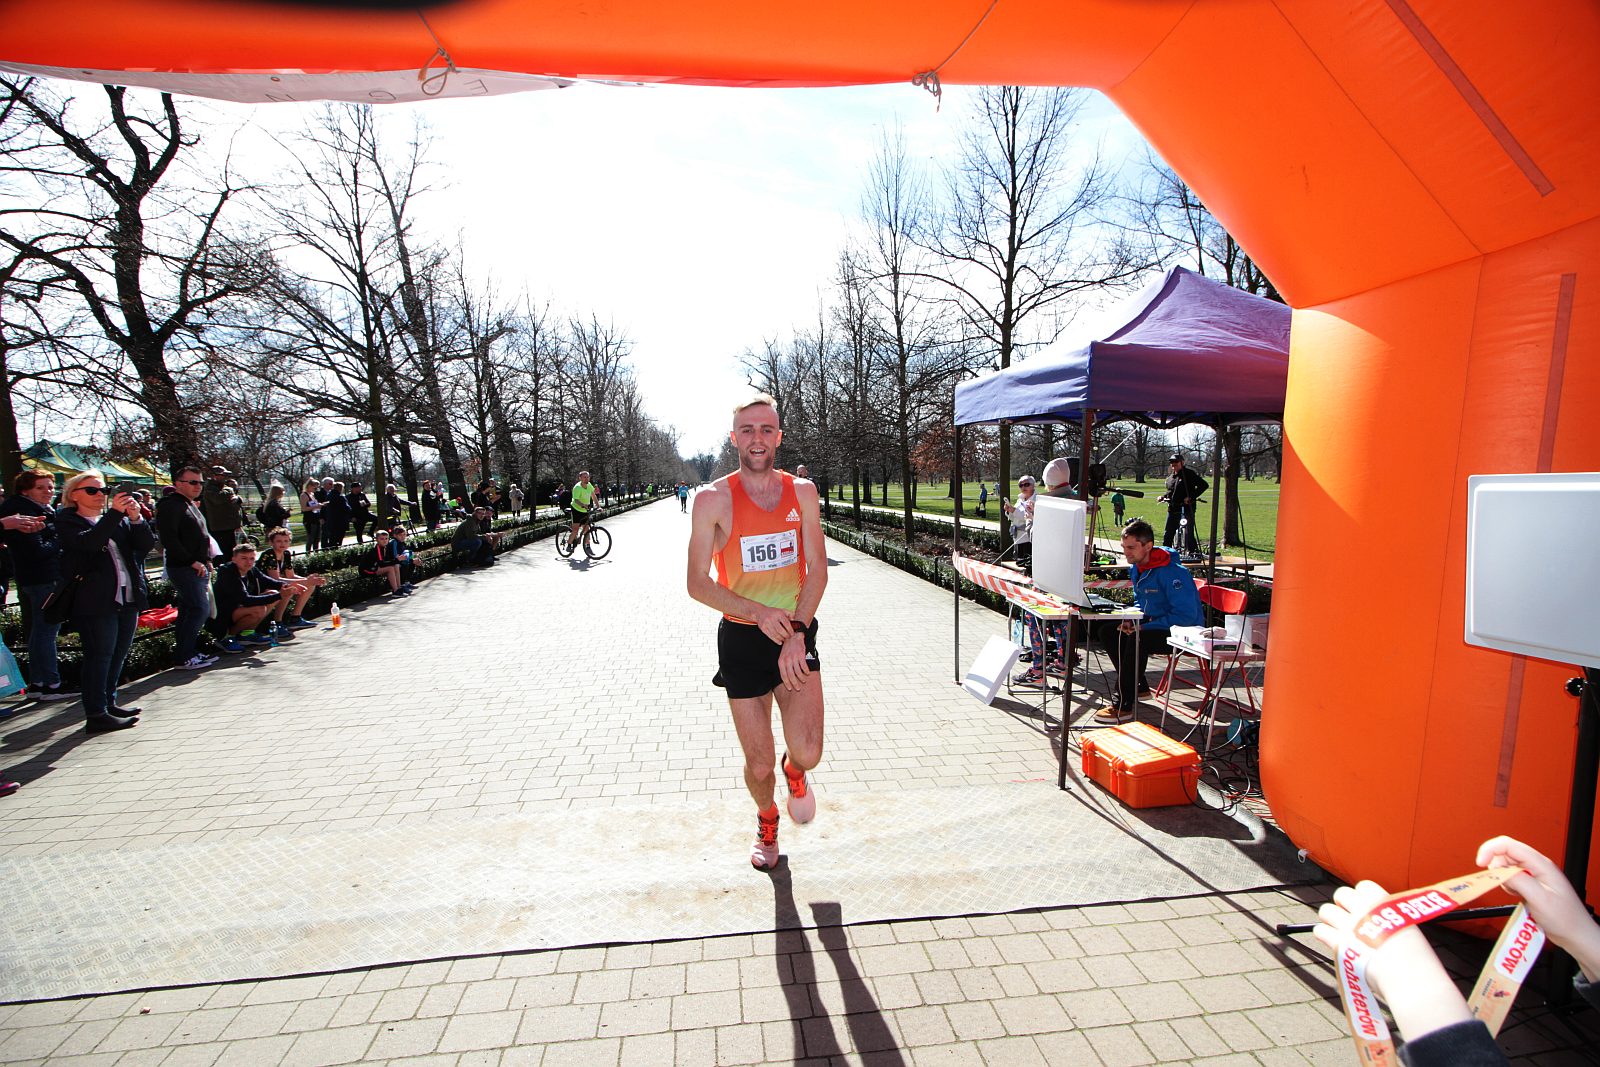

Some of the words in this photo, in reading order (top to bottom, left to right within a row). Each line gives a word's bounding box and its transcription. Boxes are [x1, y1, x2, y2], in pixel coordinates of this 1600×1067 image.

[747, 543, 777, 563] 156
[1396, 891, 1452, 920] BIEG
[1343, 947, 1380, 1038] bohaterów
